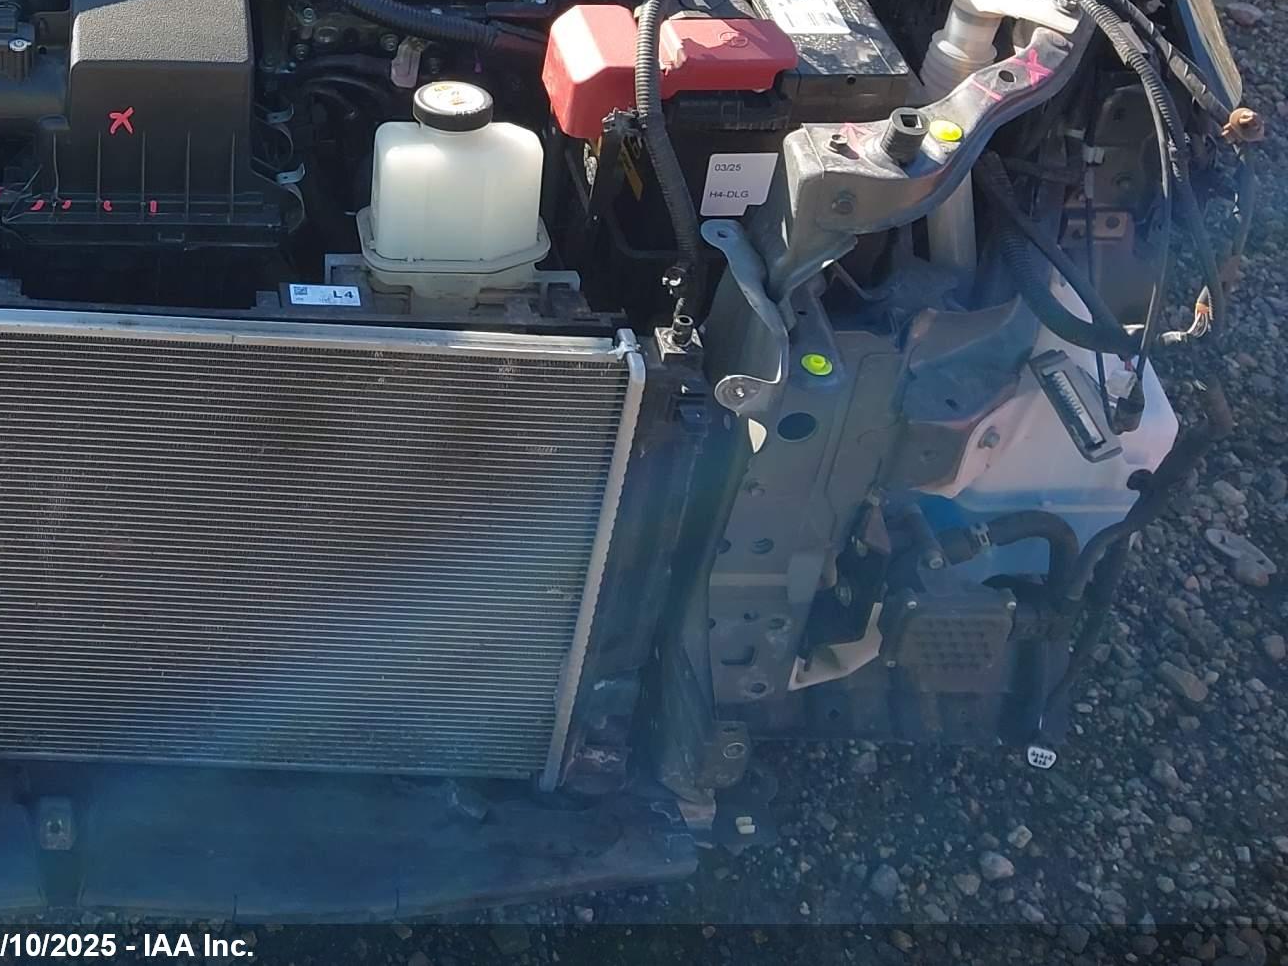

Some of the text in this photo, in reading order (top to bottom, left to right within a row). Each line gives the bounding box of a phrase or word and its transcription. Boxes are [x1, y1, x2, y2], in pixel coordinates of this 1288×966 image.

[714, 163, 742, 172] 03/25
[709, 190, 750, 199] H4-DLG
[332, 290, 354, 299] L4
